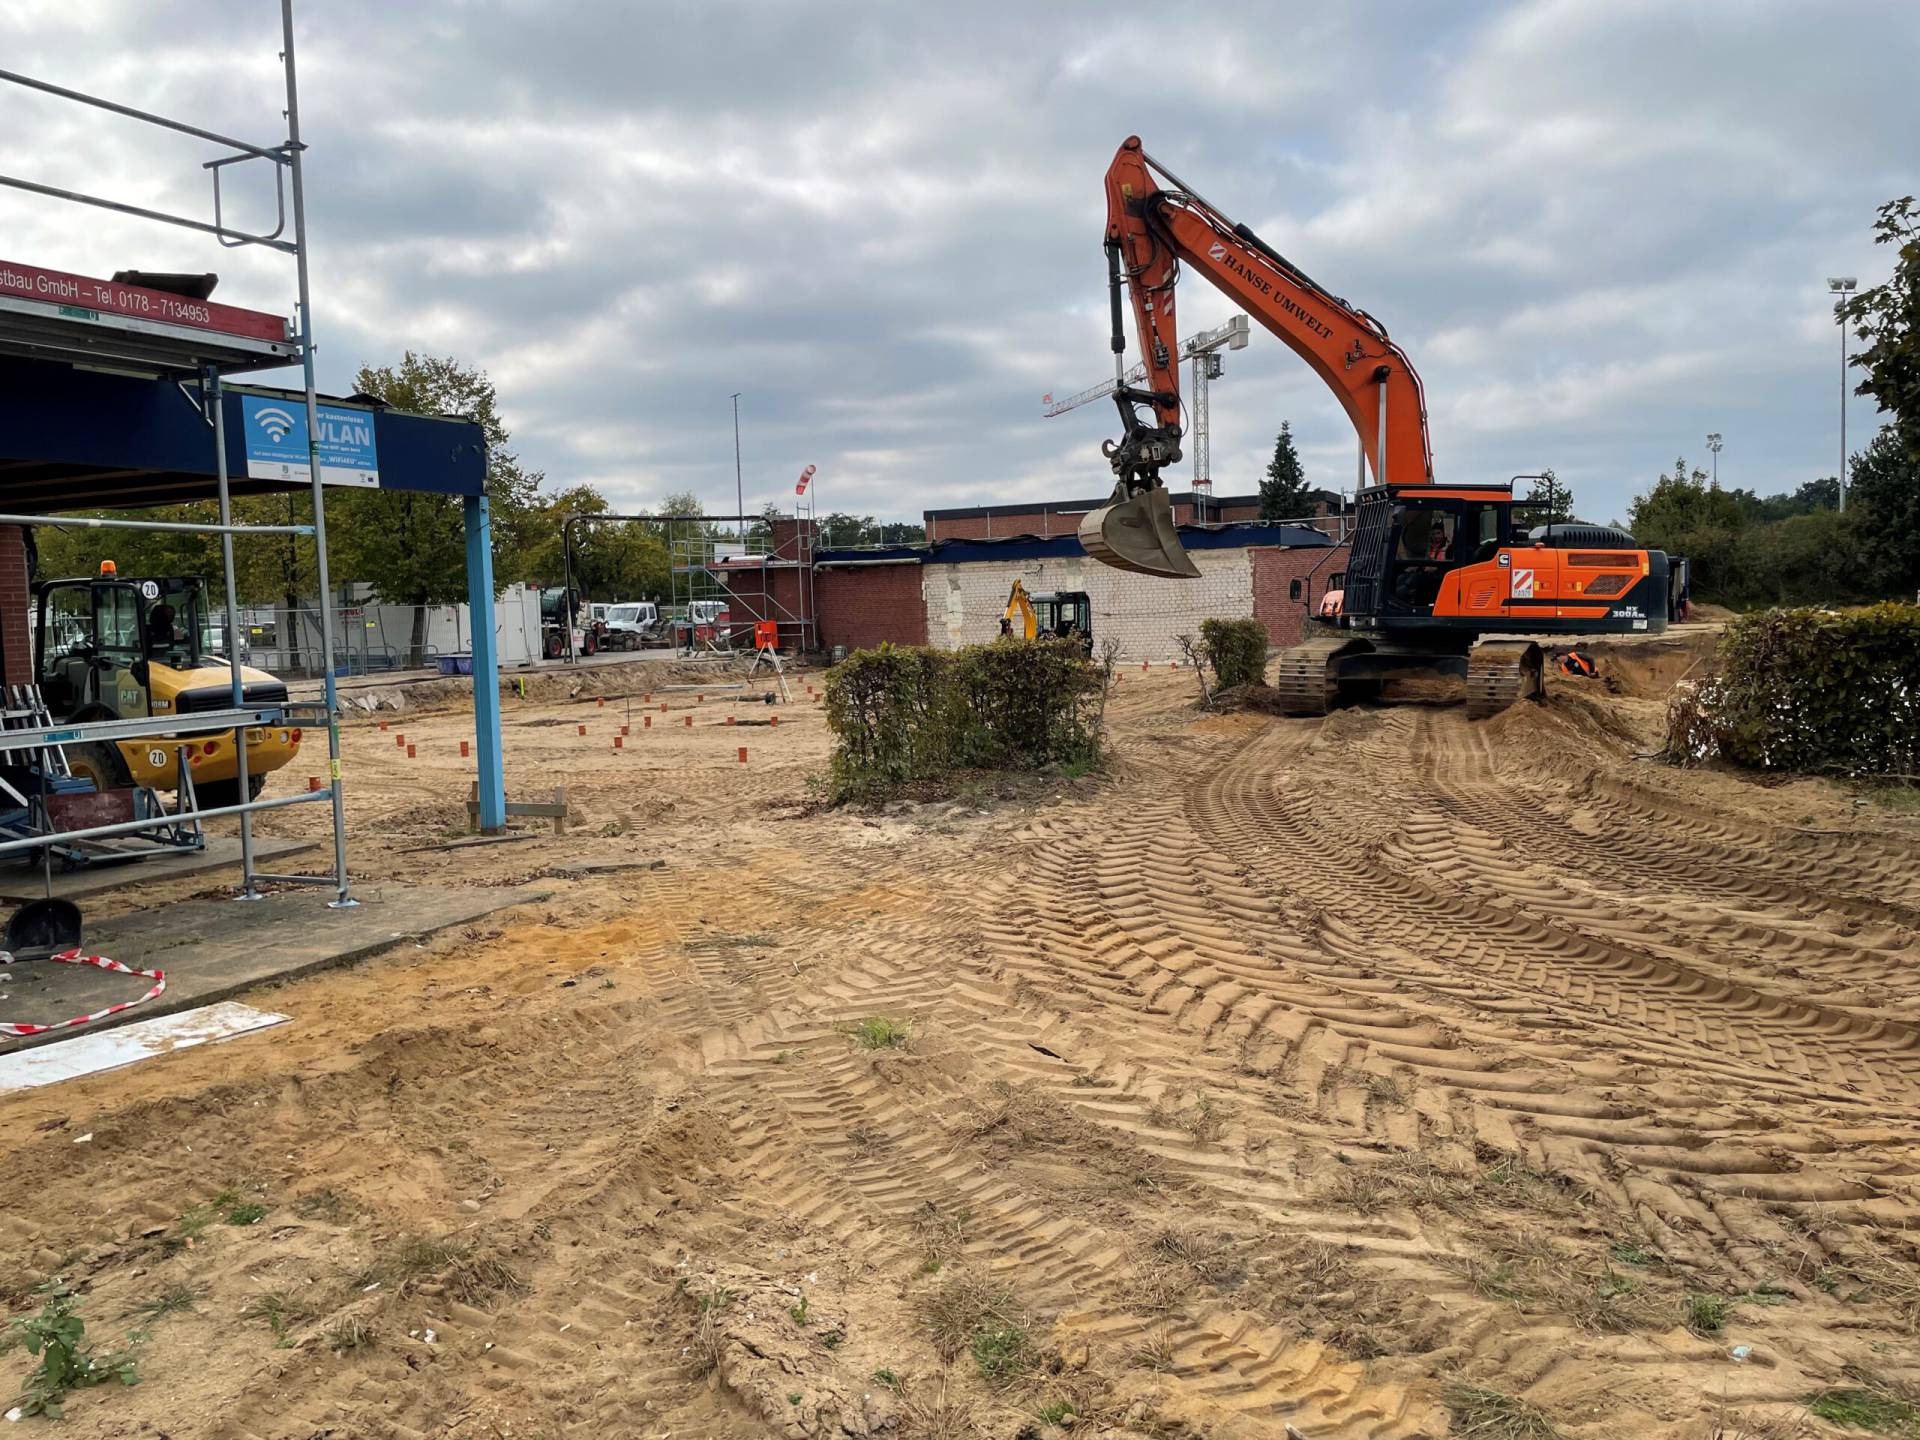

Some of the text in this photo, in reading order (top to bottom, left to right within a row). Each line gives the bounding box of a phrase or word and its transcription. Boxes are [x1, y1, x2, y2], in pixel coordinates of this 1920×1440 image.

[37, 275, 79, 298] GmbH
[94, 286, 116, 305] Tel.
[119, 291, 149, 312] 0178
[161, 299, 210, 323] 7134953
[1224, 255, 1334, 339] HANSE UMWELT
[145, 584, 156, 596] 20
[121, 690, 138, 704] CAT
[152, 752, 164, 764] 20
